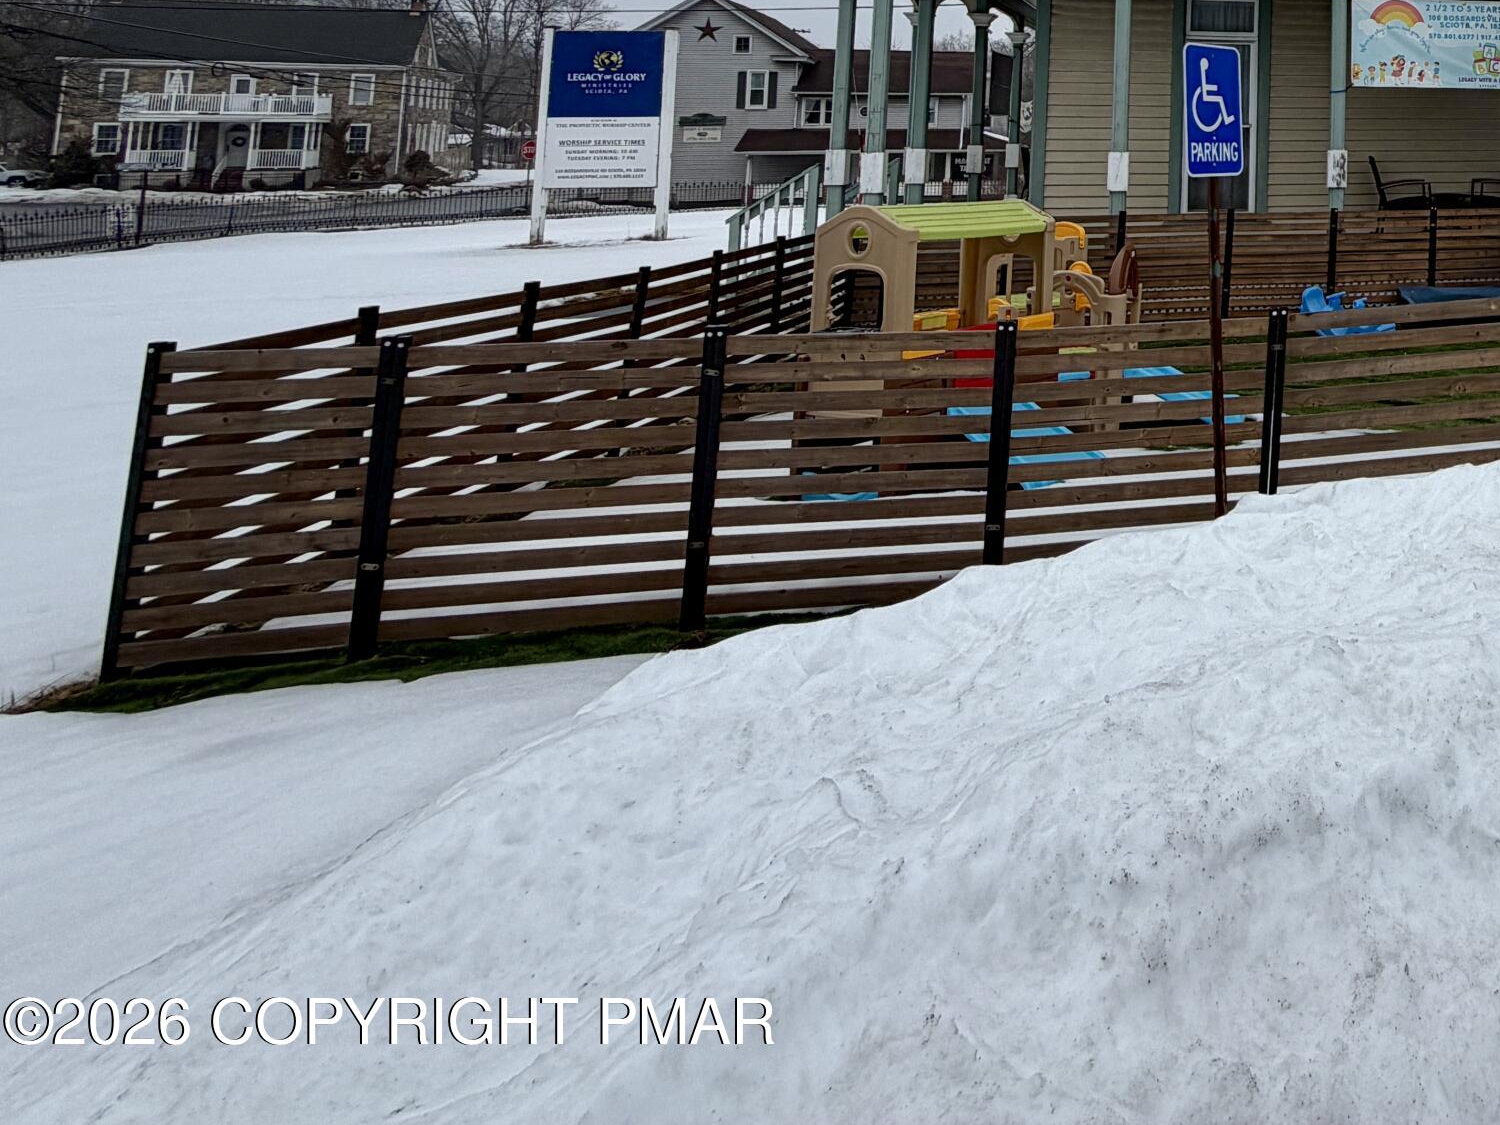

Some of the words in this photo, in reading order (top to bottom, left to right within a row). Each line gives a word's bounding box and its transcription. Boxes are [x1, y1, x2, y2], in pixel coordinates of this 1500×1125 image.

[1434, 4, 1447, 13] 1/2
[567, 73, 604, 81] LEGACY
[613, 73, 646, 81] GLORY
[1191, 142, 1239, 162] PARKING
